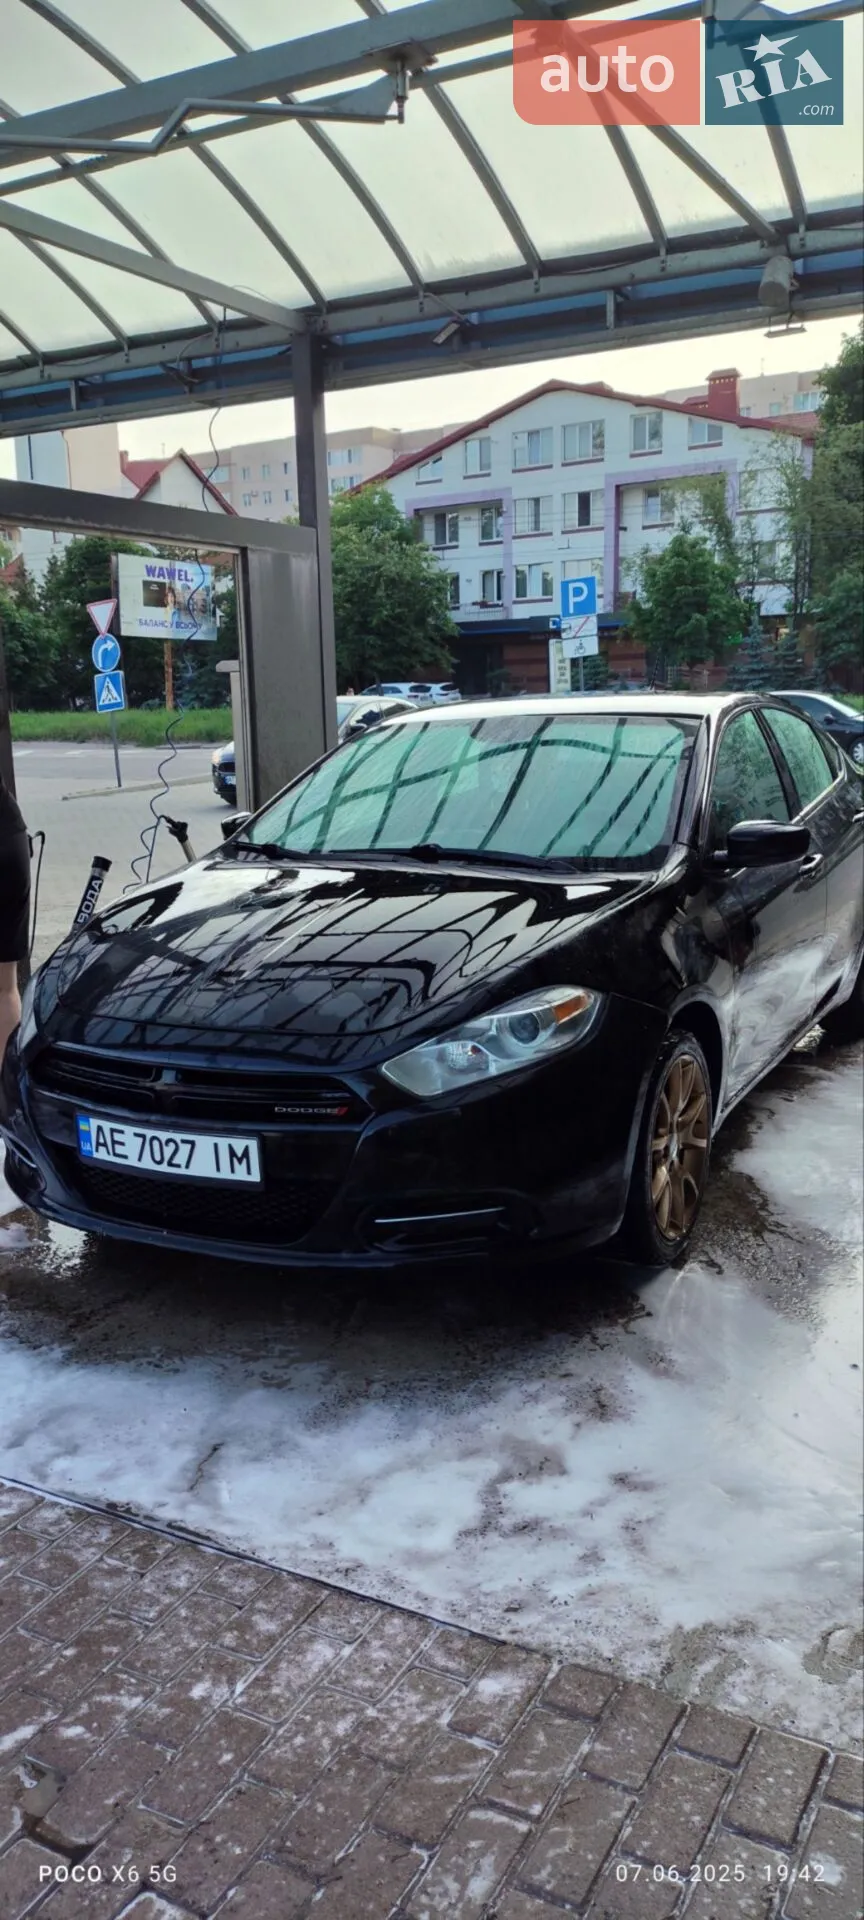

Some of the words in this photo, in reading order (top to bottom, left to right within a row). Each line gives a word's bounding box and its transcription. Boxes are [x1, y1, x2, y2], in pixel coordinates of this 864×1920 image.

[568, 582, 588, 614] P
[138, 618, 168, 629] БАЛАНС
[77, 879, 102, 923] ВОДА
[274, 1106, 339, 1114] DODGE
[80, 1140, 92, 1151] UA
[94, 1124, 129, 1160] AE
[132, 1132, 196, 1170] 7027
[213, 1142, 253, 1176] IM
